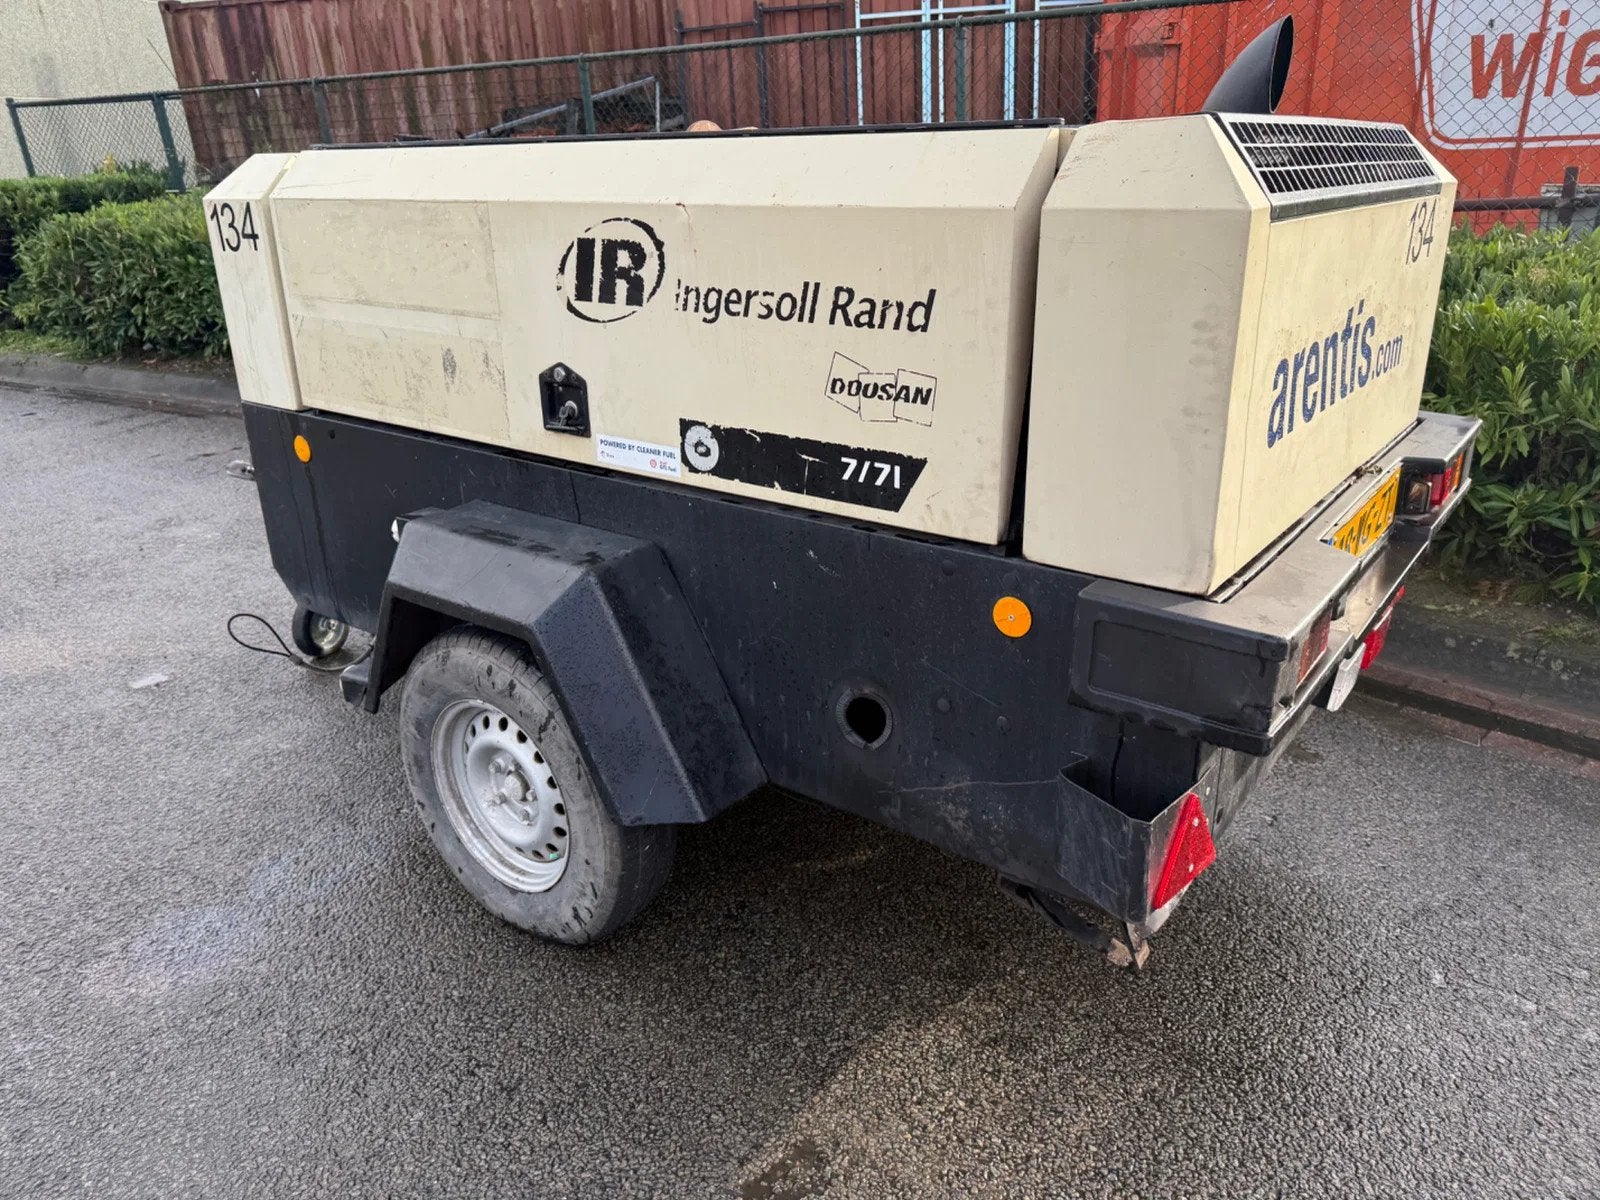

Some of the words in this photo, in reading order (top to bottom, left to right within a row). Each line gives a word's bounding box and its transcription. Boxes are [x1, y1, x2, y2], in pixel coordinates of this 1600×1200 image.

[210, 201, 259, 252] 134
[1406, 198, 1438, 265] 134
[574, 237, 647, 307] IR
[675, 278, 821, 324] Ingersoll
[829, 285, 937, 333] Rand
[1267, 299, 1403, 448] arentis.com
[600, 439, 627, 449] POWERED
[636, 445, 661, 456] CLEANER
[662, 451, 676, 459] FUEL
